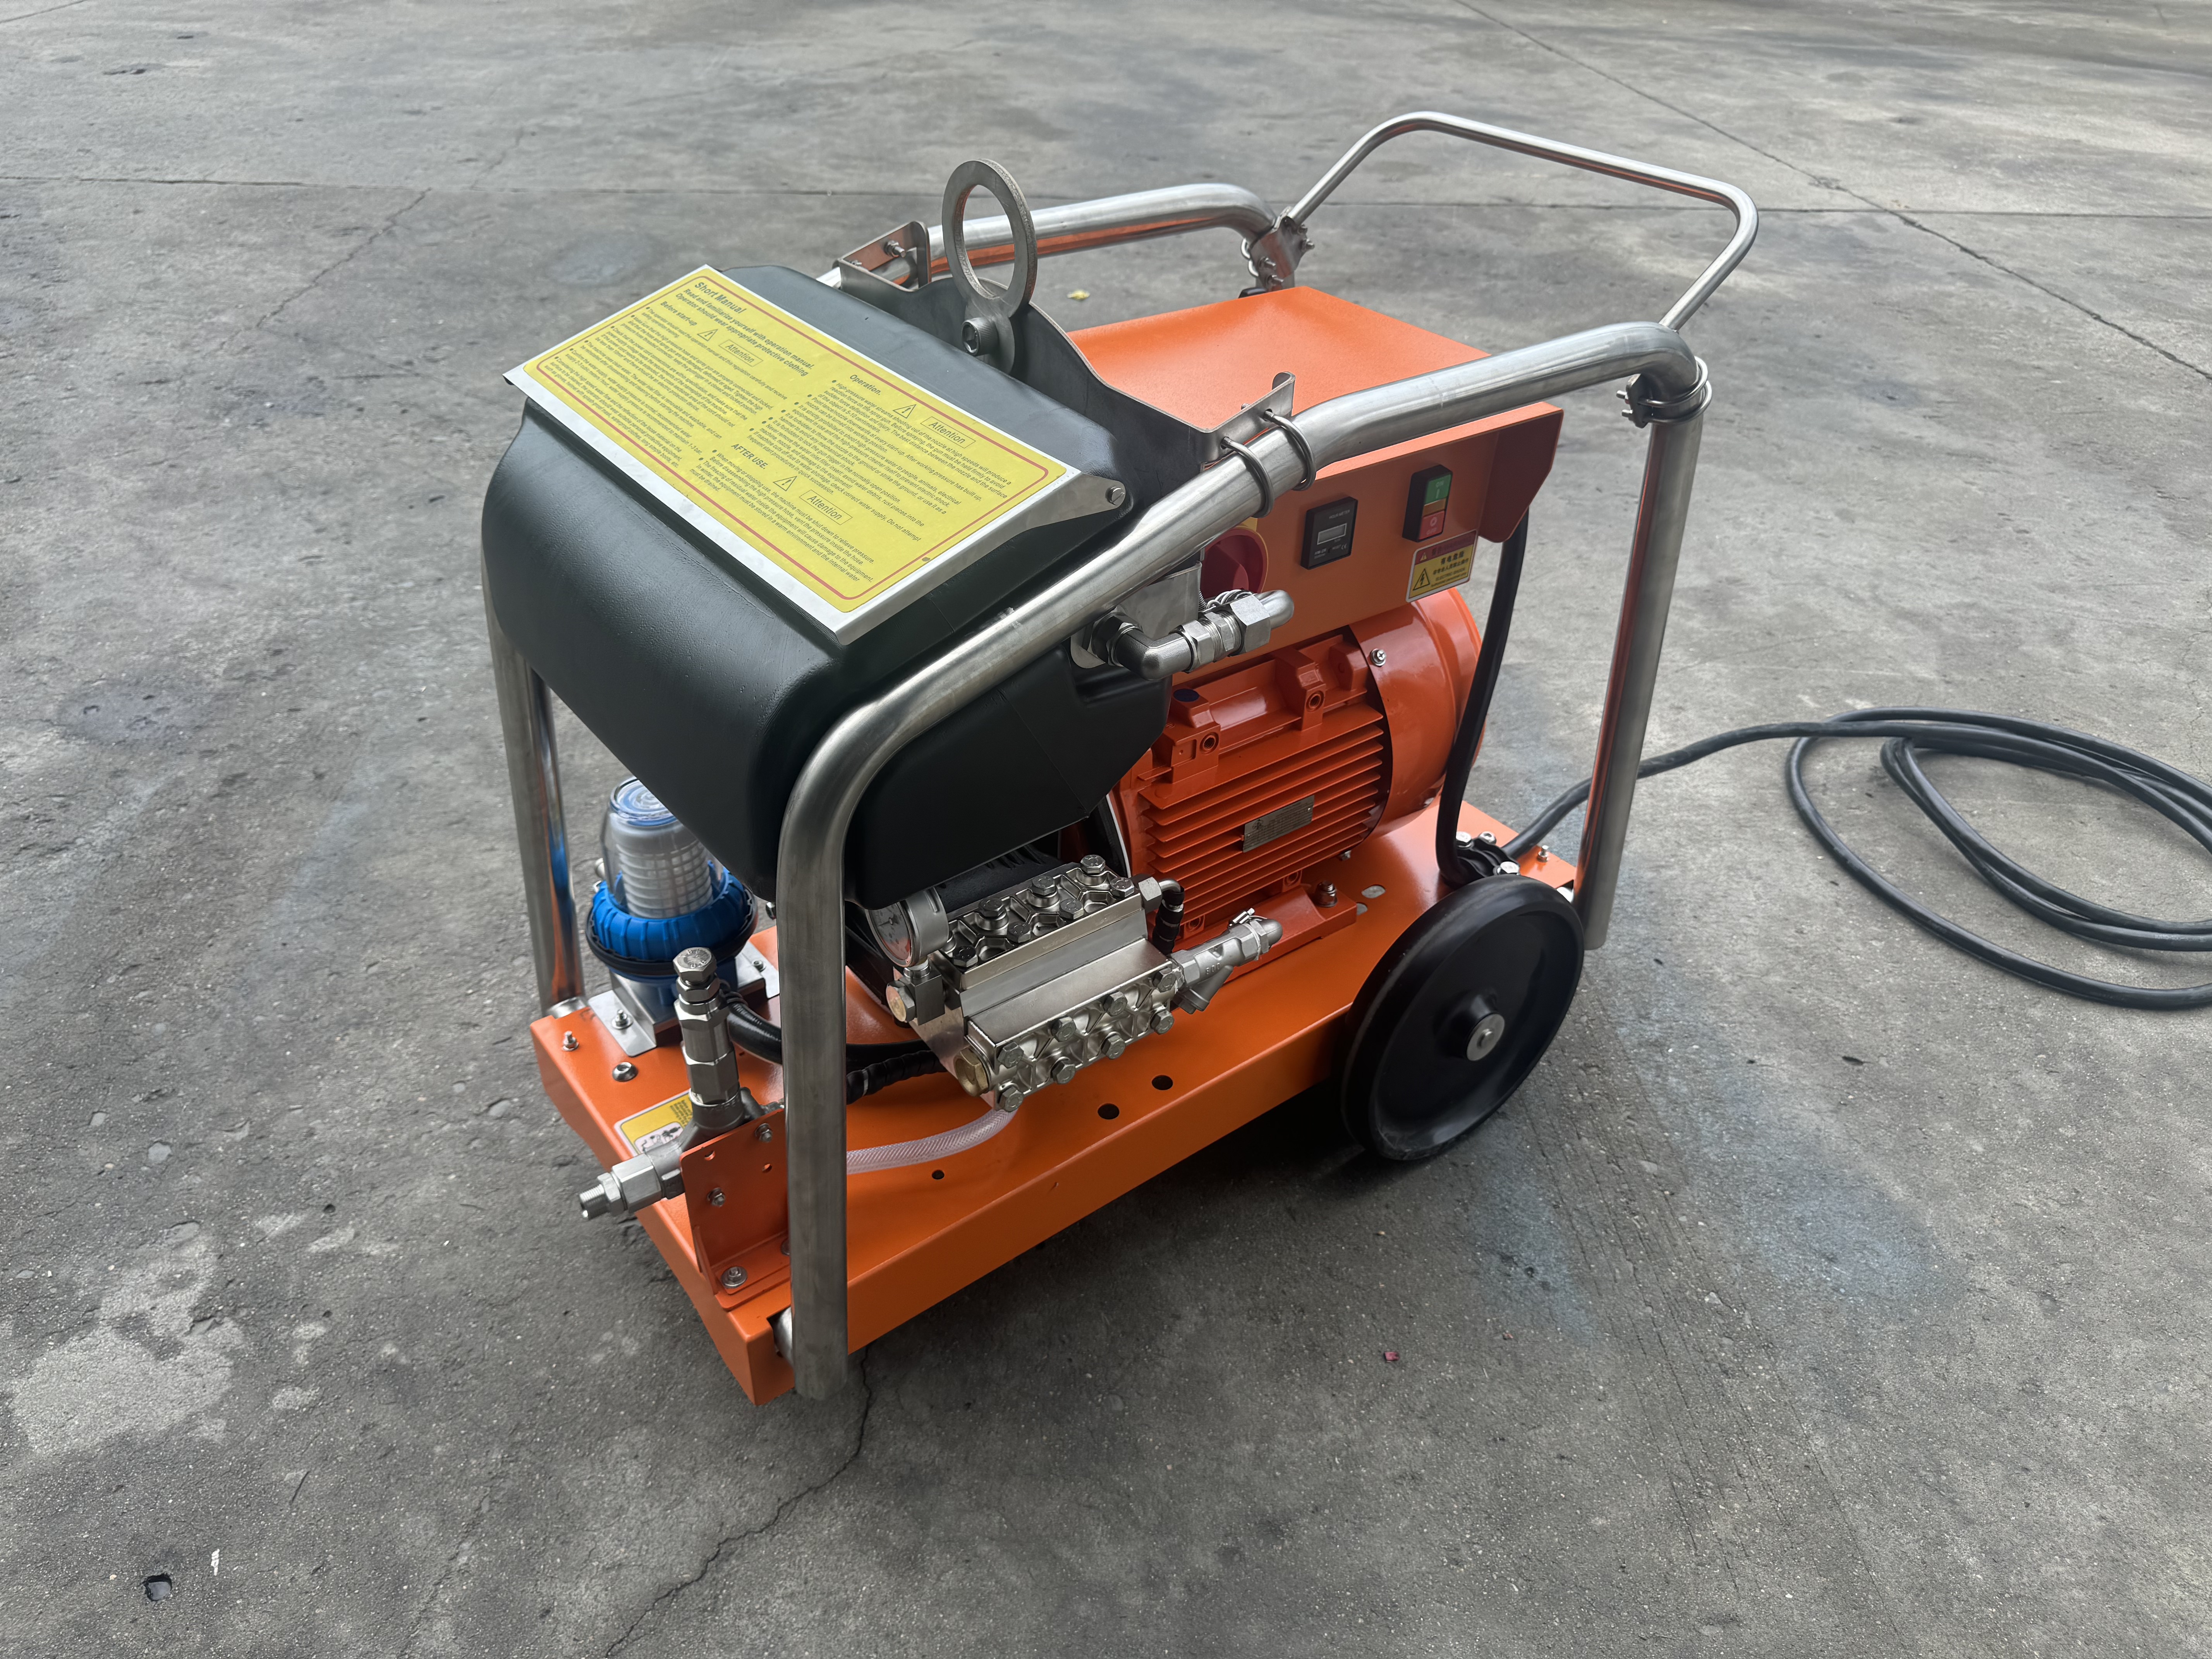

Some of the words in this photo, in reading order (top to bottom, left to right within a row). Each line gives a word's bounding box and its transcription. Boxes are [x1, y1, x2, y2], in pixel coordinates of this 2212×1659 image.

[660, 301, 678, 313] Before
[676, 312, 697, 326] start-up
[675, 293, 699, 308] Operator
[696, 307, 717, 319] should
[714, 318, 728, 326] wear
[726, 325, 757, 345] appropriate
[754, 343, 785, 361] protective
[783, 360, 808, 376] clothing
[683, 289, 699, 299] Read
[705, 302, 733, 320] familiarize
[730, 319, 756, 333] yourself
[752, 332, 766, 340] with
[764, 339, 792, 356] operation
[790, 354, 814, 369] manual.
[694, 282, 719, 297] Short
[714, 294, 747, 313] Manual
[725, 344, 754, 363] Attention
[850, 374, 881, 395] Operation.
[731, 443, 754, 459] AFTER
[752, 457, 768, 469] USE.
[811, 397, 824, 405] Point
[821, 404, 848, 421] lance/nozzle
[847, 419, 871, 434] downwards
[874, 436, 888, 445] every
[916, 461, 935, 473] working
[932, 472, 955, 484] pressure
[963, 488, 975, 496] built
[824, 390, 840, 400] sudden
[838, 398, 850, 407] force
[877, 422, 891, 431] injury.
[898, 434, 911, 443] best
[909, 441, 928, 453] distance
[927, 451, 948, 465] between
[954, 468, 971, 478] nozzle
[988, 487, 1007, 498] surface
[829, 401, 843, 410] object
[855, 417, 880, 433] centimeters.
[830, 386, 847, 398] reaction
[846, 396, 858, 404] force
[869, 410, 883, 419] spray
[891, 422, 906, 433] Before
[905, 432, 926, 445] spraying,
[970, 469, 986, 478] firmly
[989, 480, 1005, 488] avoid
[836, 383, 865, 401] High-pressure
[875, 407, 893, 417] streams
[892, 417, 912, 429] shooting
[930, 439, 946, 448] nozzle
[961, 456, 979, 467] speeds
[985, 471, 1007, 482] produce
[928, 422, 965, 443] Attention
[689, 469, 701, 477] must
[780, 424, 799, 438] forbidden
[826, 455, 842, 465] trigger
[851, 471, 871, 484] normally
[870, 483, 882, 491] open
[879, 490, 900, 503] position.
[805, 410, 820, 420] strictly
[817, 418, 842, 432] prohibited
[843, 434, 857, 442] shoot
[855, 440, 885, 460] high-pressure
[884, 459, 898, 467] water
[900, 469, 918, 481] people,
[918, 479, 937, 493] animals,
[938, 491, 961, 505] electrical
[710, 466, 727, 479] freezing
[729, 481, 747, 493] residual
[745, 491, 757, 500] water
[756, 499, 769, 509] inside
[775, 513, 799, 530] equipment
[804, 534, 818, 544] cause
[817, 543, 836, 556] damage
[847, 563, 873, 582] equipment.
[716, 452, 728, 462] When
[726, 461, 742, 472] moving
[745, 474, 764, 487] stopping
[778, 497, 796, 510] machine
[795, 509, 808, 517] must
[821, 527, 834, 536] down
[837, 538, 854, 549] relieve
[851, 548, 874, 564] pressure.
[807, 496, 842, 519] Attention
